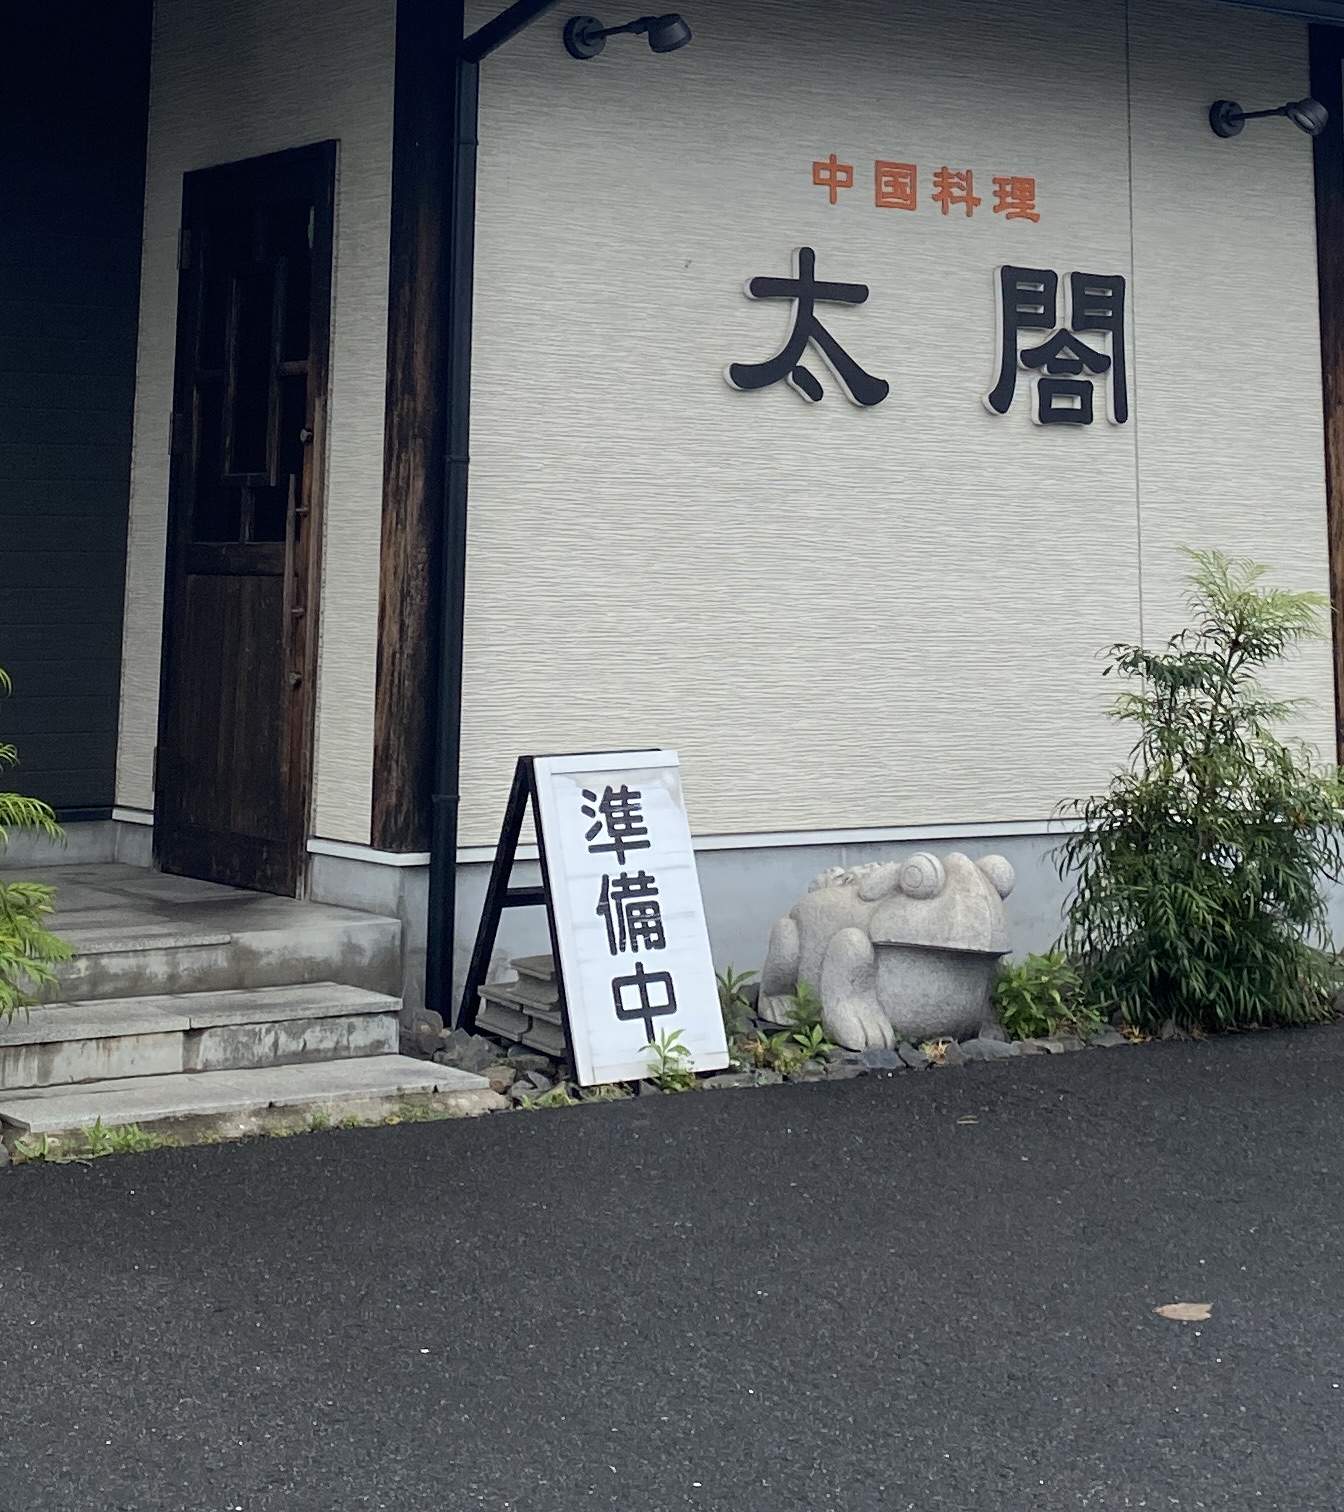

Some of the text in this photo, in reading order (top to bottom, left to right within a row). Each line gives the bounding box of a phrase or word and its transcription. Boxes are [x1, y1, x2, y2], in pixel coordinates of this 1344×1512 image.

[812, 154, 1041, 222] 中国料理
[725, 246, 1128, 426] 太閤
[581, 785, 677, 1044] 準備中
